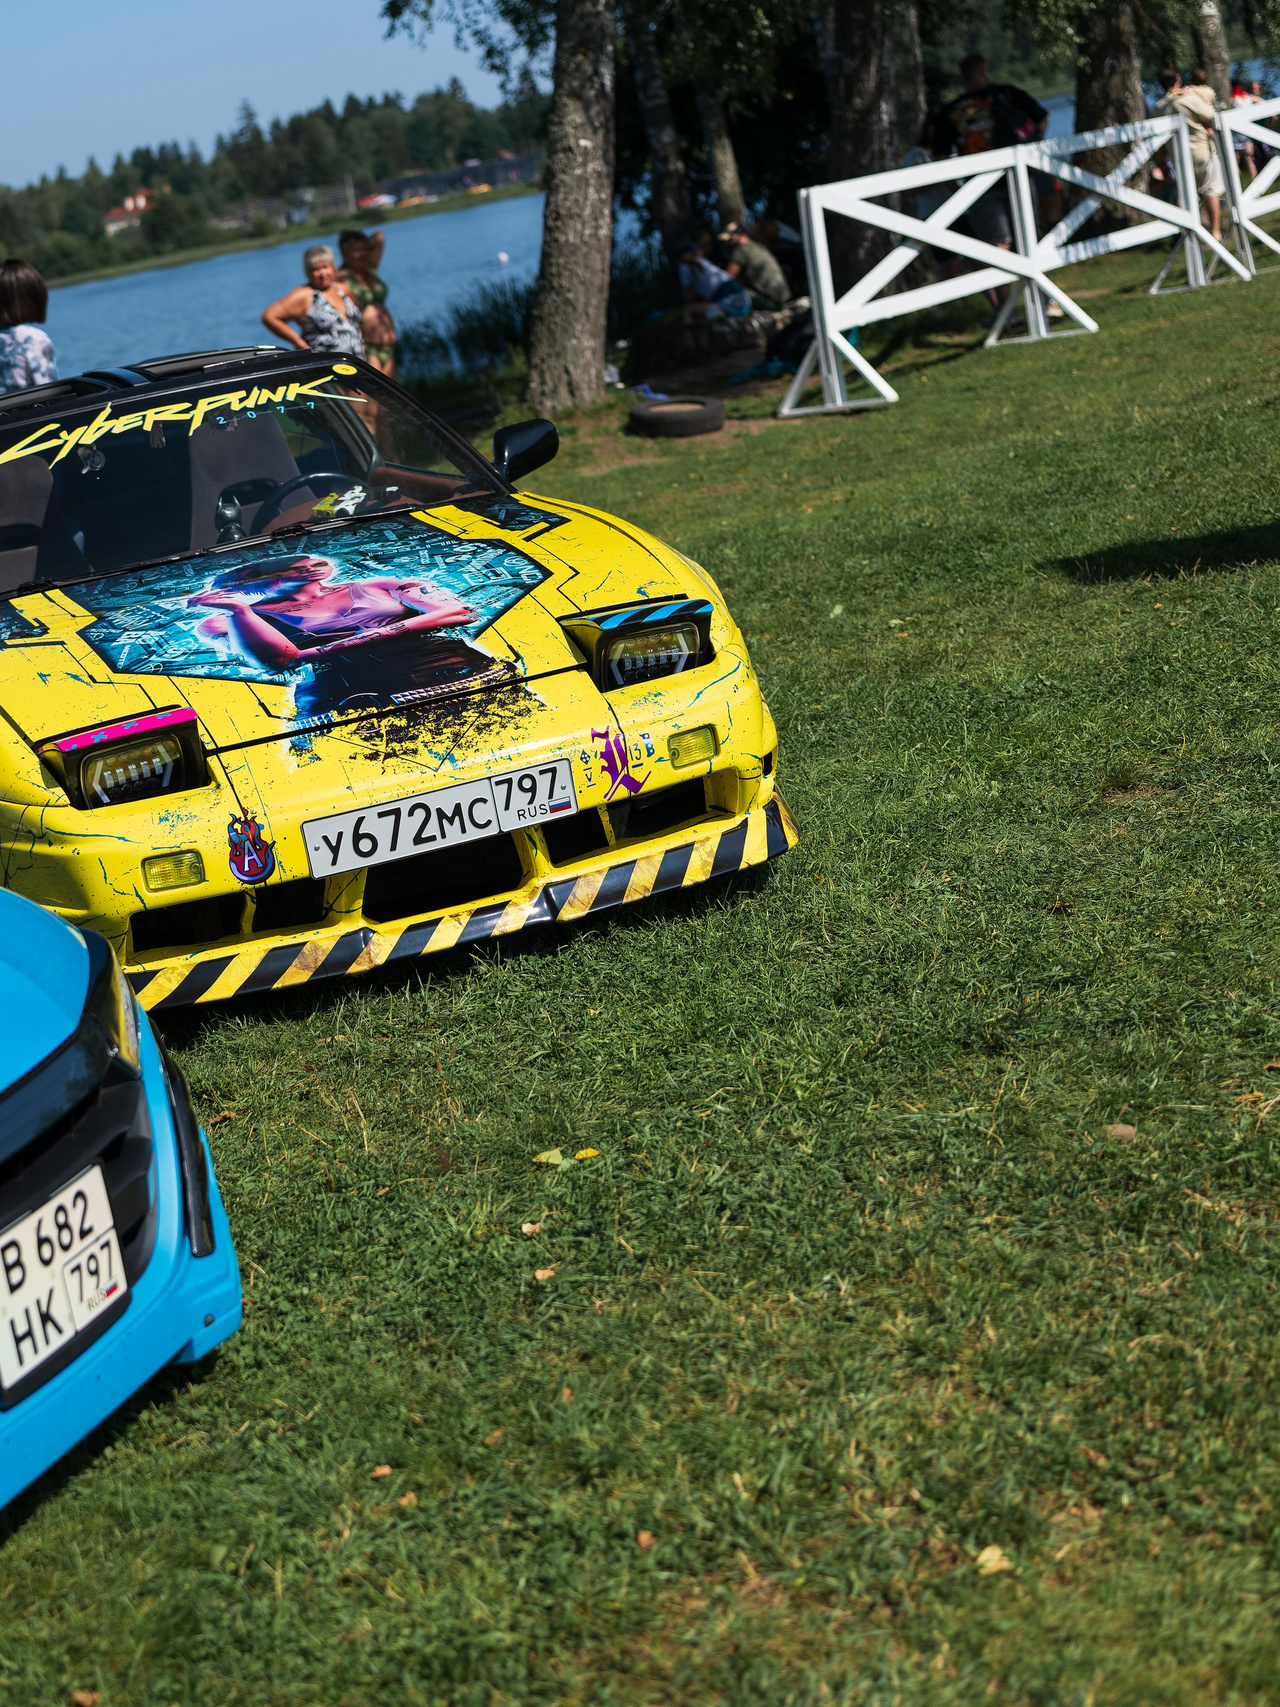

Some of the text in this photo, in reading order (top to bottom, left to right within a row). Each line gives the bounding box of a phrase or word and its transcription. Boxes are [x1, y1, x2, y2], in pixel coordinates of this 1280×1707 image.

[494, 766, 557, 811] 797
[516, 803, 549, 821] RUS
[0, 1189, 95, 1294] В 682
[70, 1240, 114, 1304] 797
[86, 1286, 108, 1312] RUS
[10, 1287, 63, 1366] НК
